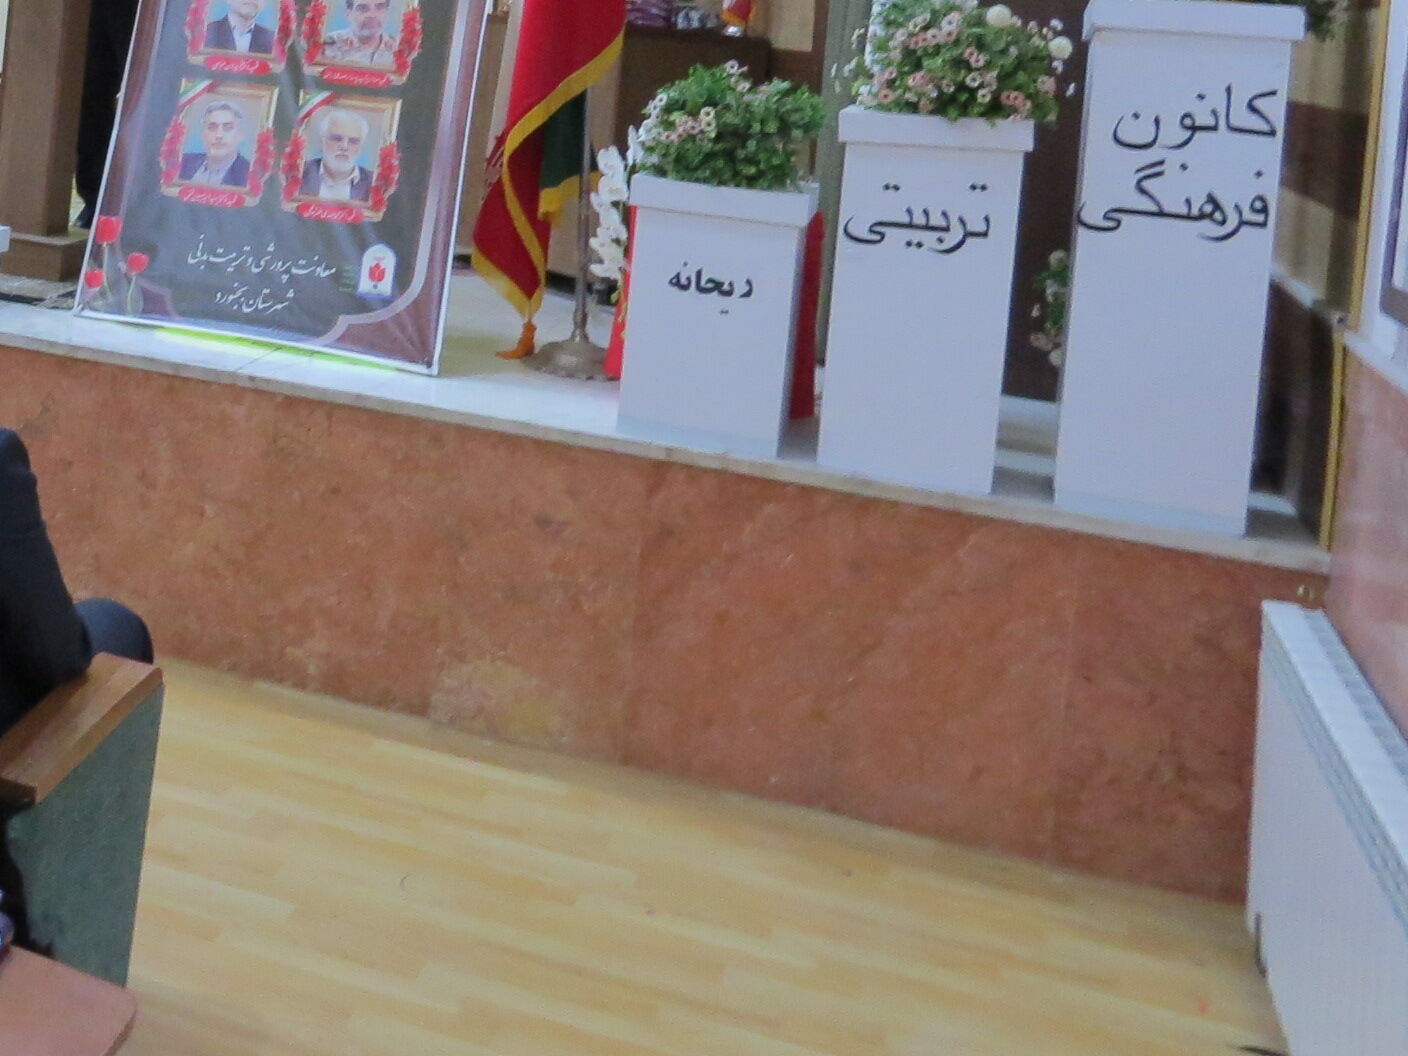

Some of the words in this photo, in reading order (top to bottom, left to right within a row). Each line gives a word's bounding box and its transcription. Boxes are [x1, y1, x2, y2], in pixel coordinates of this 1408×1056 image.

[1112, 82, 1278, 150] کانون
[843, 182, 991, 255] تربیتی
[1077, 157, 1269, 242] فرهنگی
[187, 233, 210, 270] بدنی
[208, 245, 251, 272] تربیت
[251, 241, 293, 284] پرورشی
[291, 254, 337, 278] معاونت
[214, 281, 249, 310] بجنورد
[241, 287, 295, 314] شهرستان
[668, 260, 754, 316] ریحانه
